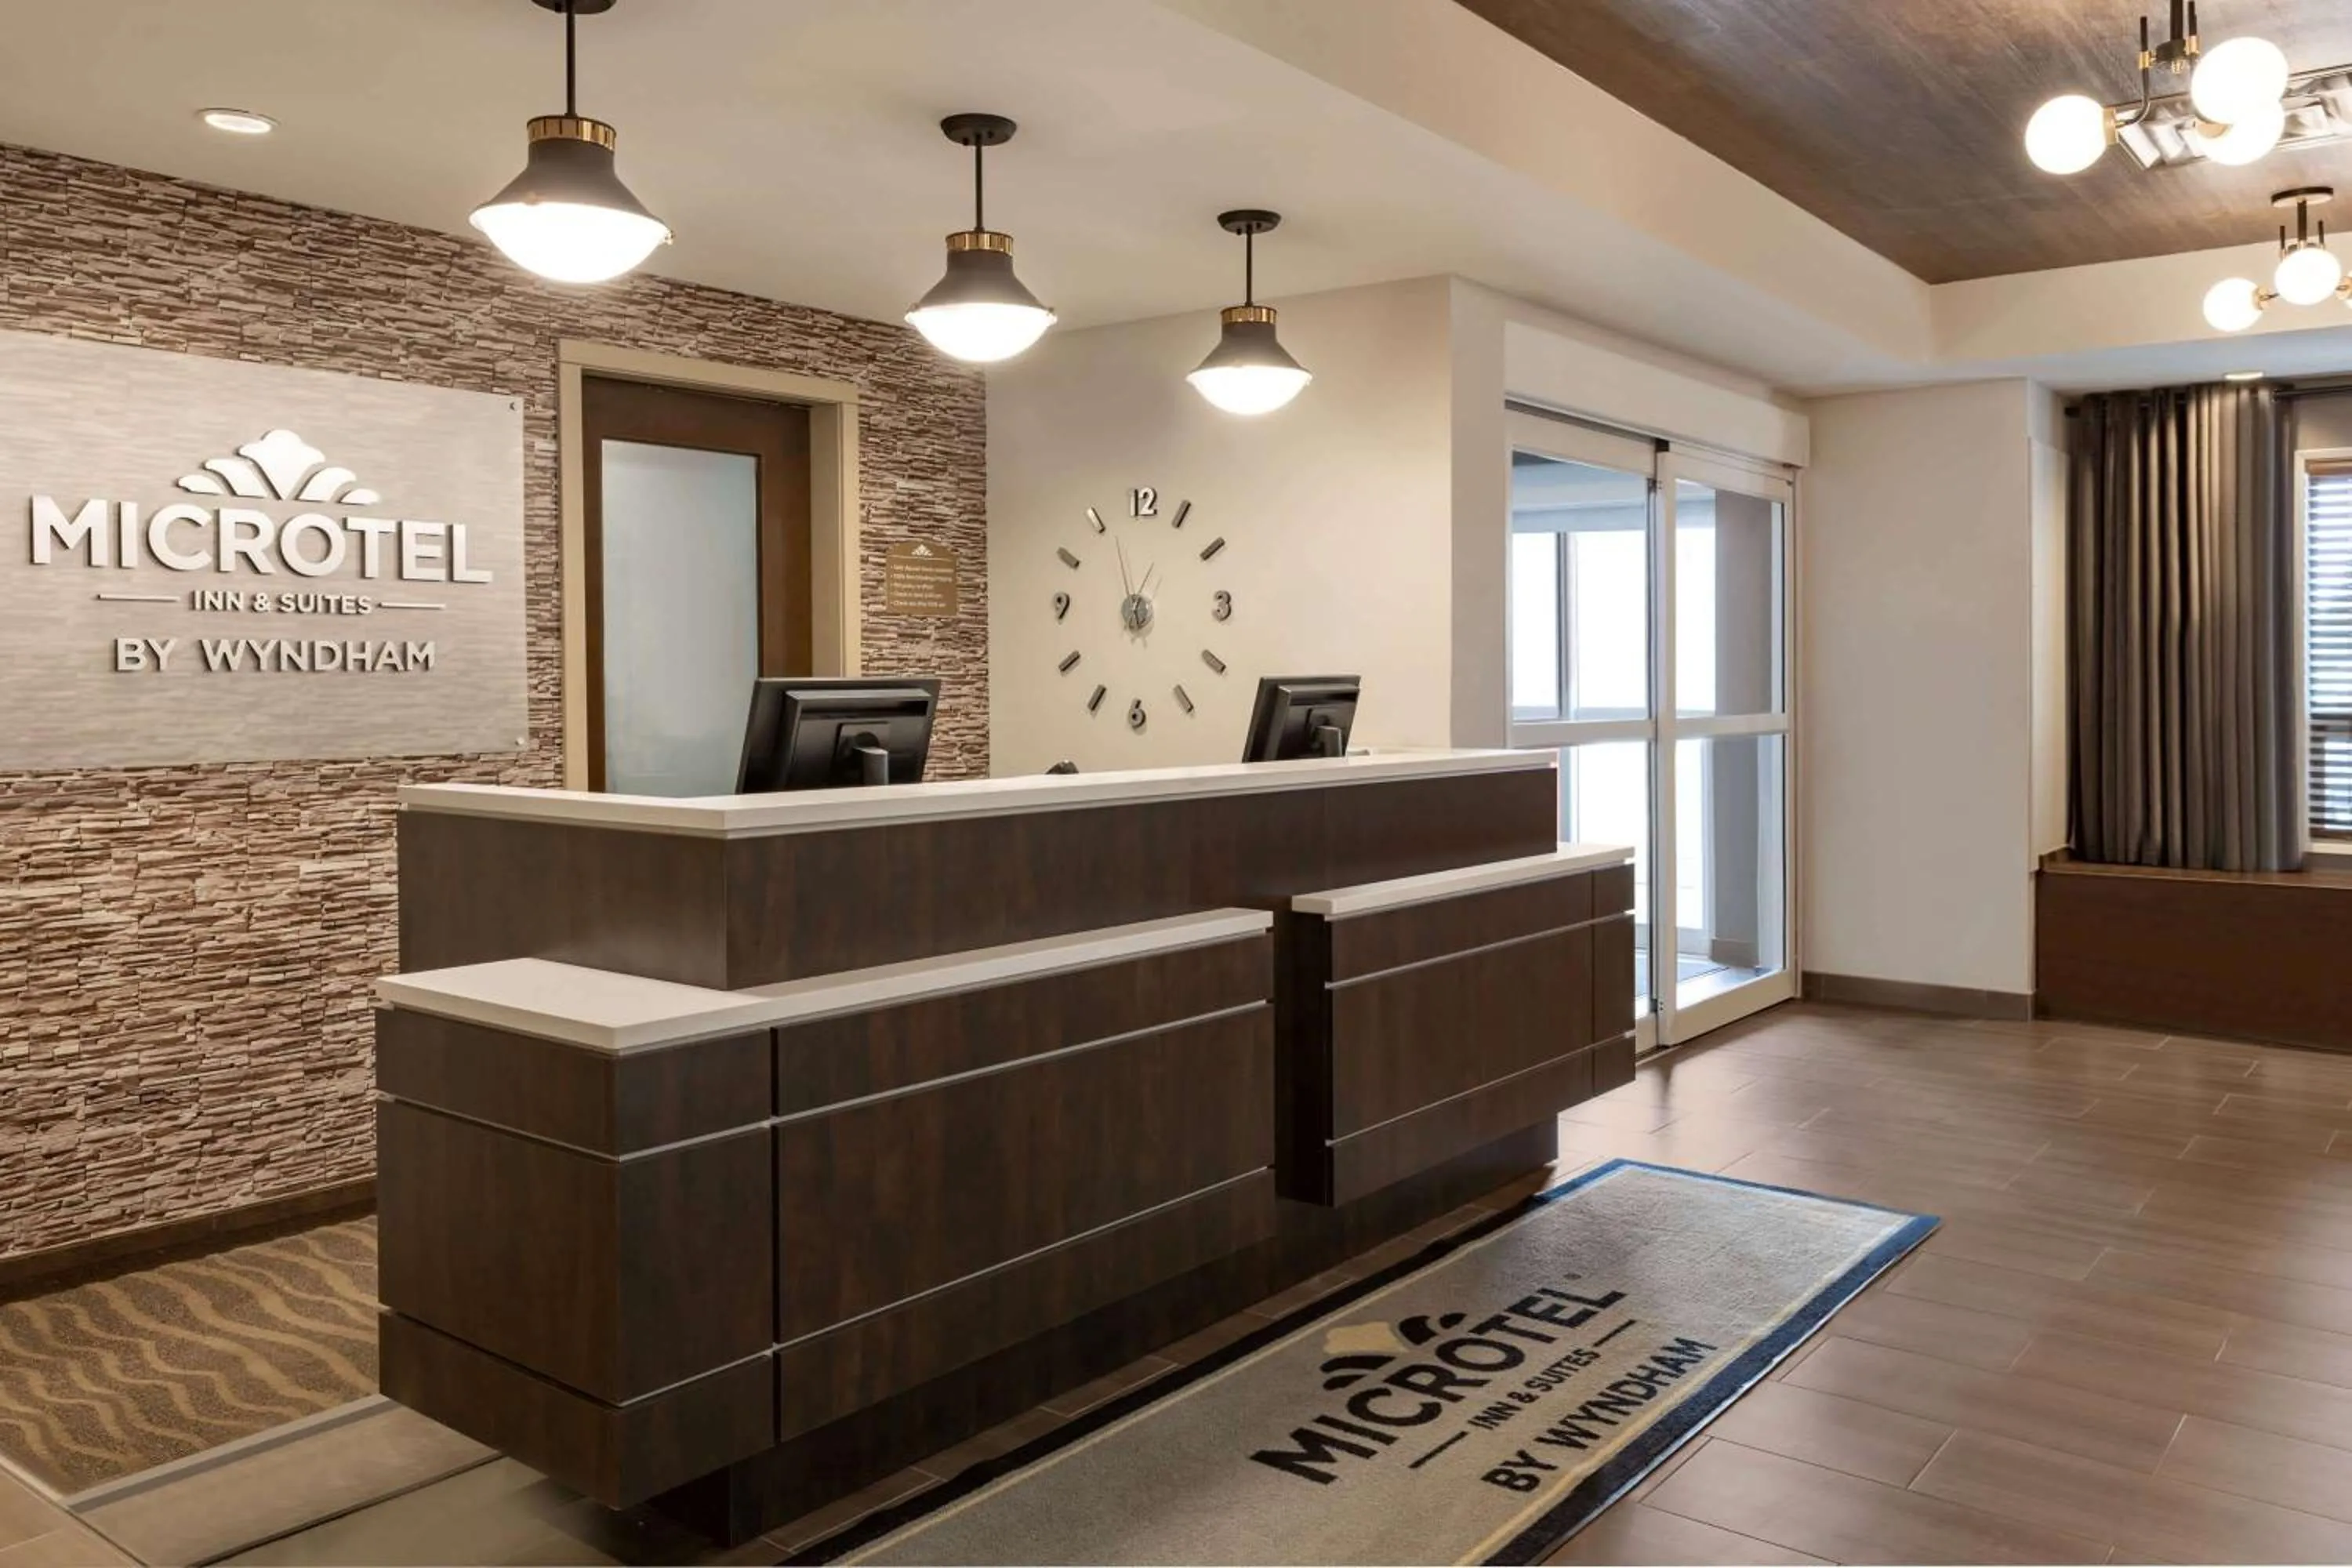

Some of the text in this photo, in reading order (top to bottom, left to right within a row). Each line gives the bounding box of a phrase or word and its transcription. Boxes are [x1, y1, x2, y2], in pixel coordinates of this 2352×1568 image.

[1130, 487, 1158, 517] 12
[30, 494, 492, 583] MICROTEL
[191, 590, 372, 615] INN & SUITES
[1054, 591, 1070, 619] 9
[1214, 590, 1232, 621] 3
[114, 637, 437, 672] BY WYNDHAM
[1128, 699, 1145, 728] 6
[1249, 1287, 1628, 1485] MICROTEL
[1468, 1348, 1602, 1432] INN & SUITES
[1480, 1337, 1719, 1494] BY WYNDHAM
